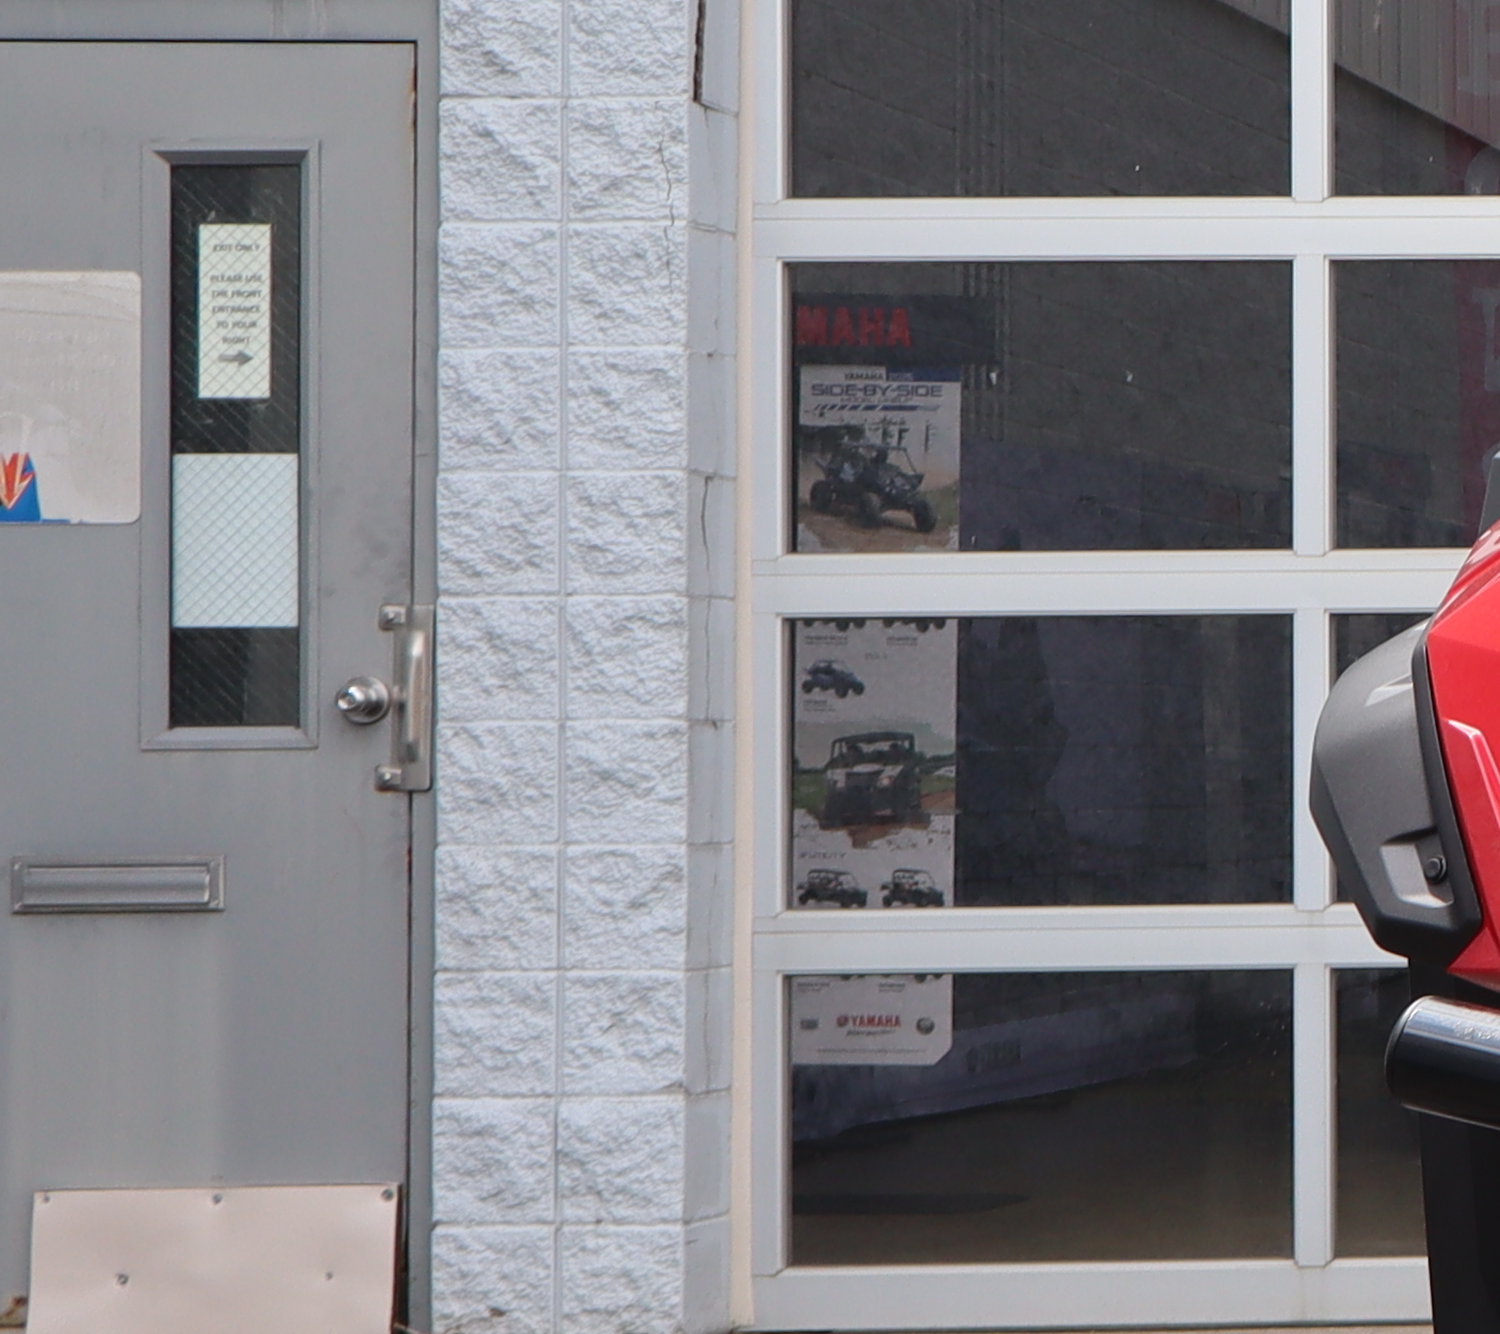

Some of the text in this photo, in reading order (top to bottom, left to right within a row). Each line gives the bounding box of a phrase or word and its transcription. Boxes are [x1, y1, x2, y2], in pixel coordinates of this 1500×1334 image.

[213, 243, 260, 252] EXIT ONLY
[210, 274, 243, 283] PLEASE
[231, 289, 262, 298] FRONT
[212, 305, 261, 314] ENTRANCE
[232, 320, 258, 329] YOUR
[796, 306, 913, 347] MAHA
[222, 336, 251, 345] RIGHT
[844, 372, 884, 381] YAMAHA
[811, 383, 943, 398] SIDE-BY-SIDE
[852, 1015, 902, 1028] YAMAHA
